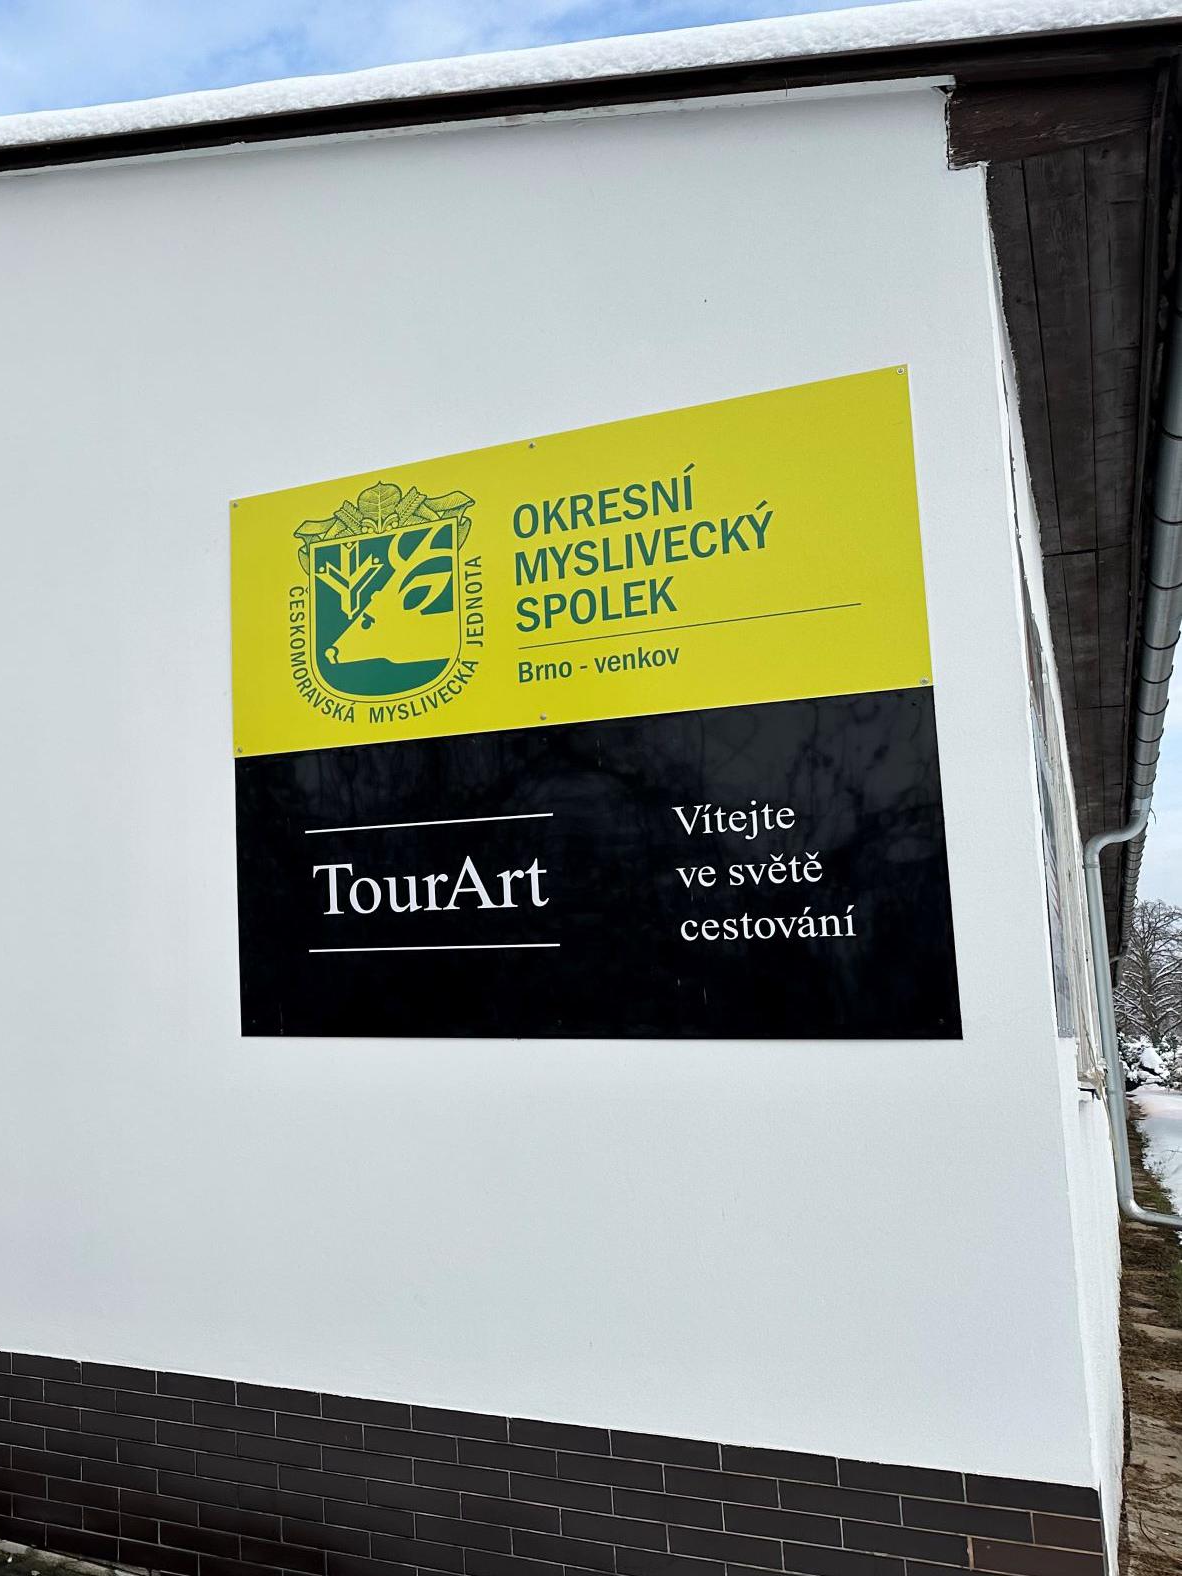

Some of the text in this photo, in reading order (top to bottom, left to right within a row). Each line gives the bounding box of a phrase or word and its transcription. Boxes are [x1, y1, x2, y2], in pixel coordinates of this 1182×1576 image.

[514, 464, 694, 538] OKRESNÍ
[516, 500, 773, 586] MYSLIVECKÝ
[516, 576, 677, 632] SPOLEK
[290, 556, 483, 723] ČESKOMORAVSKÁ MYSLIVECKÁ JEDNOTA
[519, 662, 572, 683] Brno
[595, 647, 679, 673] venkov
[672, 801, 795, 839] Vítejte
[313, 856, 549, 914] TourArt
[676, 852, 822, 887] ve světě
[681, 905, 856, 941] cestování
